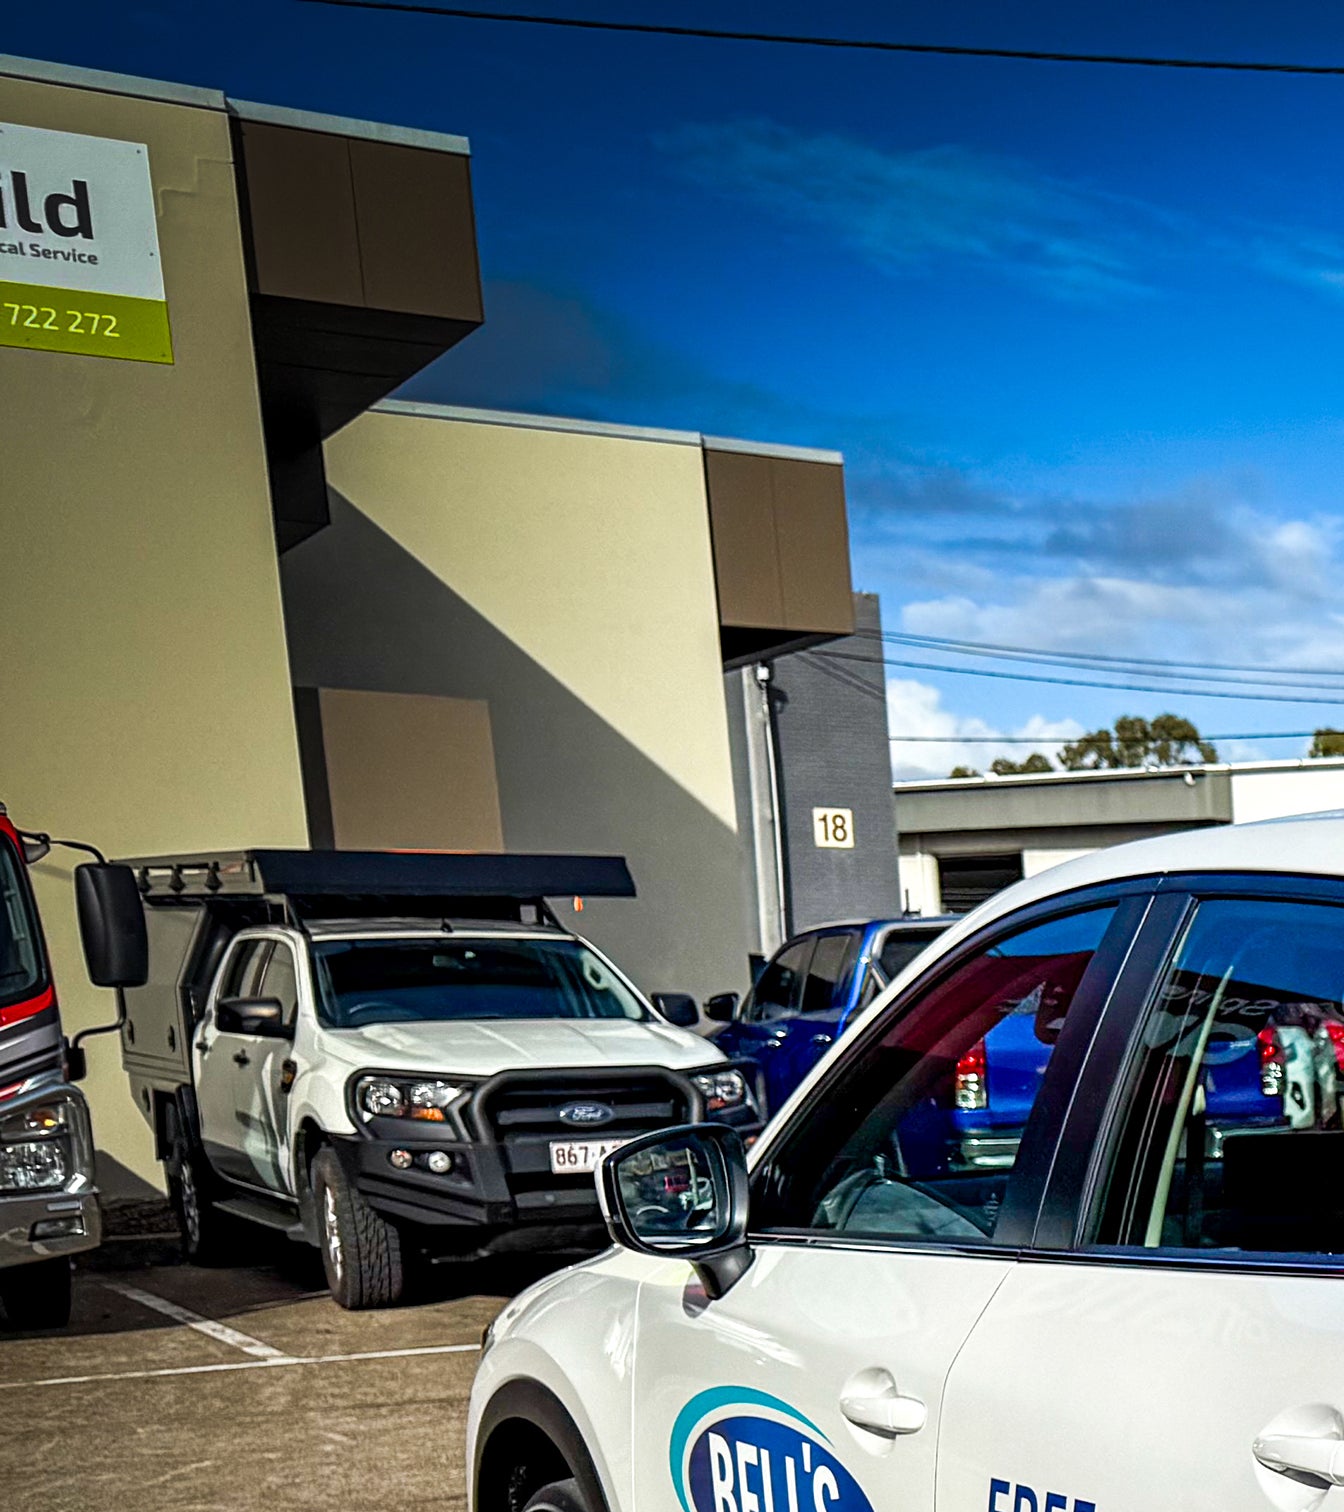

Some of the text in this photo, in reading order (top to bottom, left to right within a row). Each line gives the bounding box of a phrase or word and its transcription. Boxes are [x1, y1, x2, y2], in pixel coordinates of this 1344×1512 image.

[29, 243, 99, 266] Service
[4, 303, 121, 337] 722 272
[818, 813, 848, 842] 18
